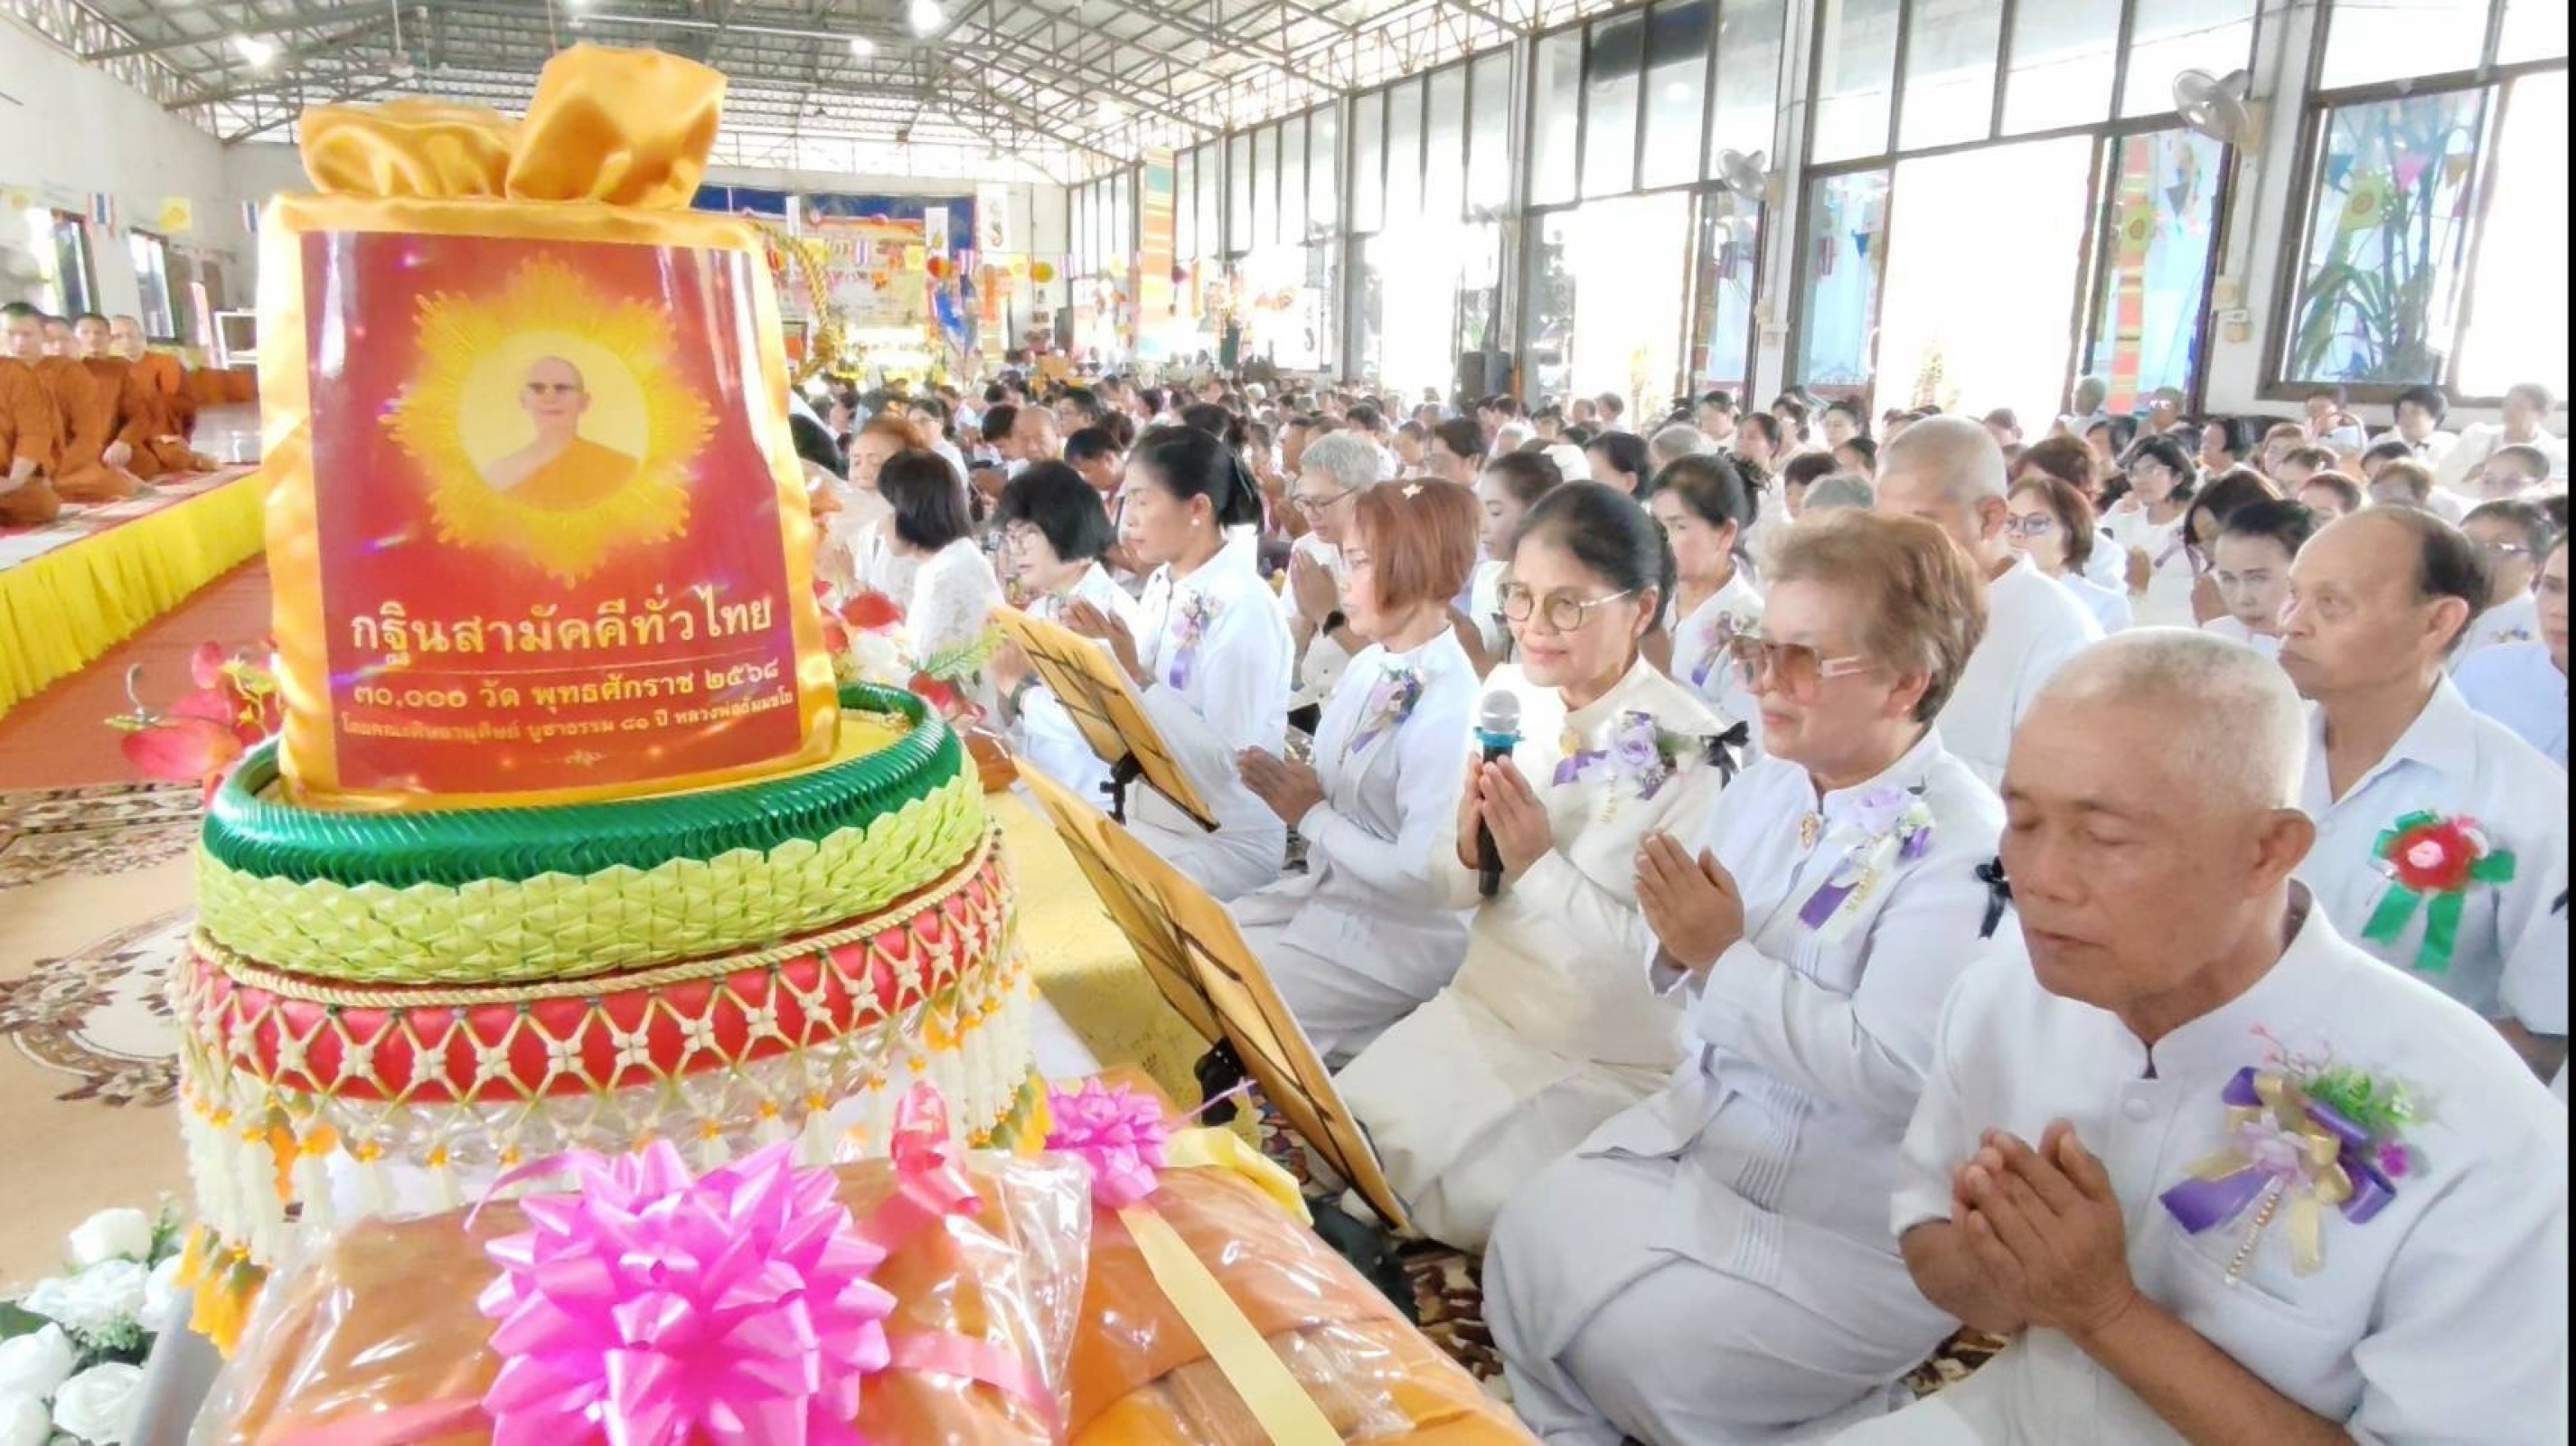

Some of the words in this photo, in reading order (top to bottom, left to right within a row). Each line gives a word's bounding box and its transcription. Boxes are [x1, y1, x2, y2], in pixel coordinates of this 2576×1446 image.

[351, 583, 773, 667] กฐินสามัคคีทั่วไทย
[479, 679, 521, 708] วัด
[531, 672, 694, 715] พุทธศักราช
[705, 658, 779, 690] ๒๕๖๘
[653, 709, 669, 728] ปี
